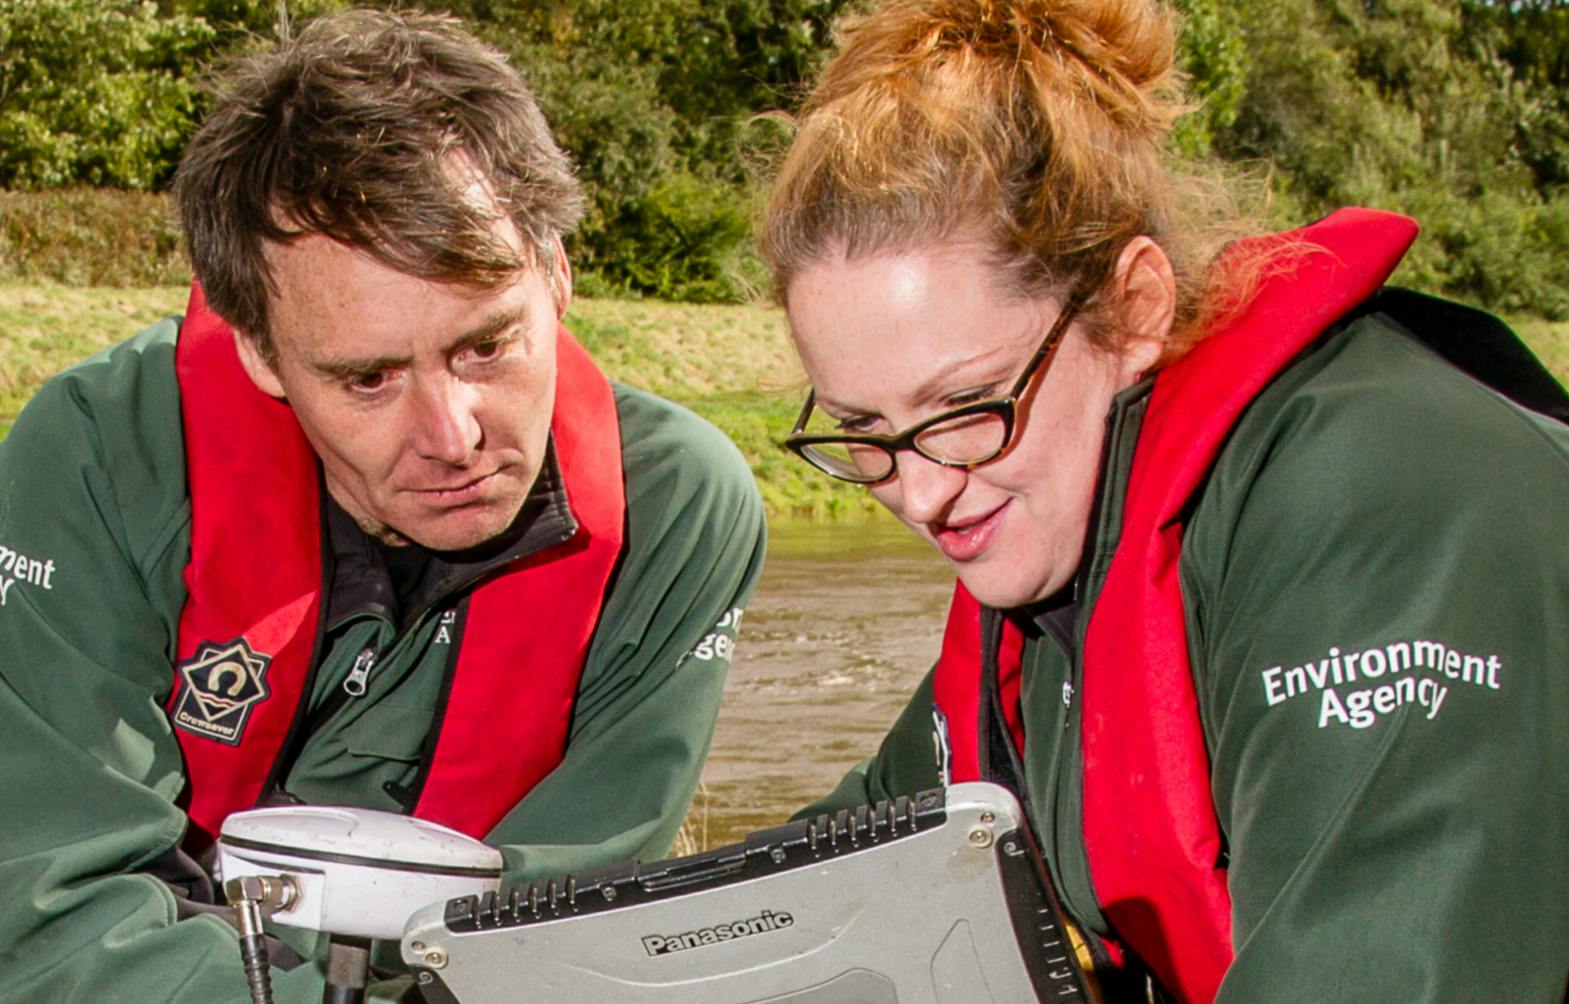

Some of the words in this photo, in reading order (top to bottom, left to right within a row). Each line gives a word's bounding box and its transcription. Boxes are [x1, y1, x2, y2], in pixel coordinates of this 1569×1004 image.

[1262, 640, 1502, 707] Environment
[1318, 676, 1447, 729] Agency
[641, 910, 795, 957] Panasonic
